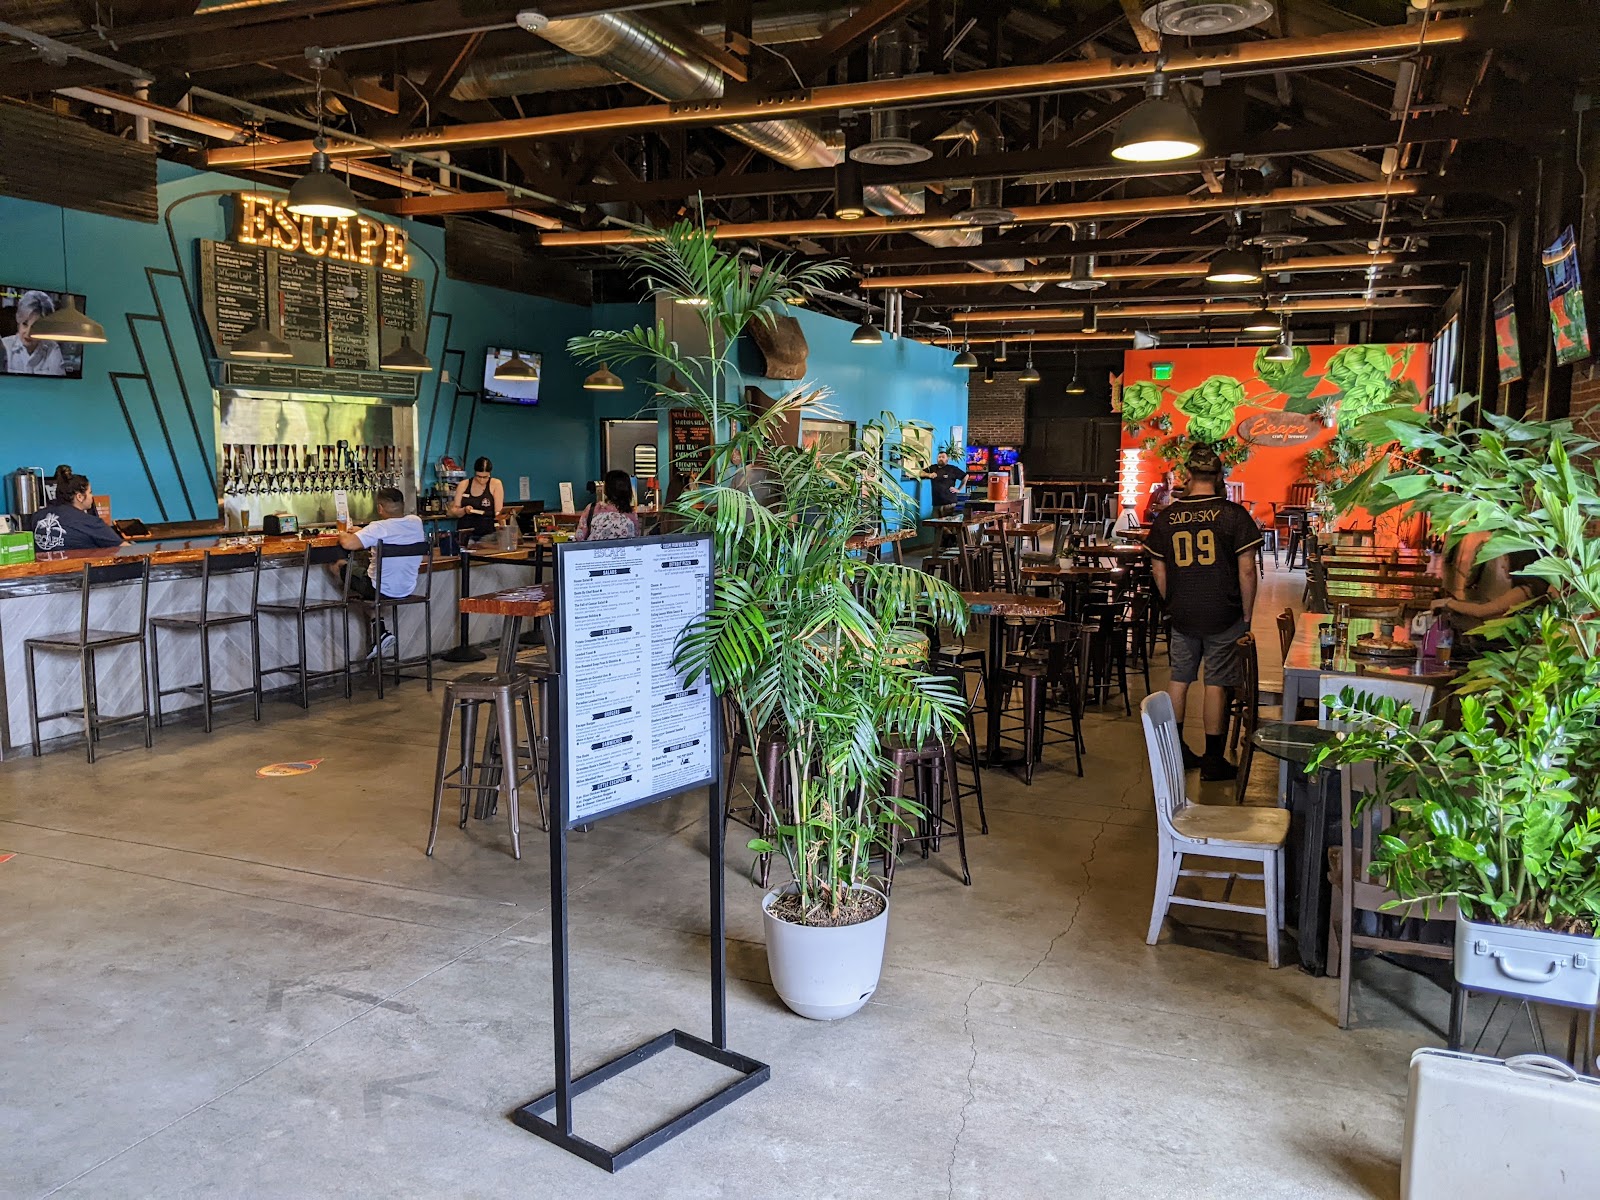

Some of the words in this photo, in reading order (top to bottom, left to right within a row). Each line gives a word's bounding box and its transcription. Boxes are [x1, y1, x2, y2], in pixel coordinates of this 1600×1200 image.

[238, 192, 408, 272] ESCAPE
[1250, 418, 1308, 442] Escape
[1198, 510, 1220, 523] SKY
[1172, 528, 1216, 568] 09
